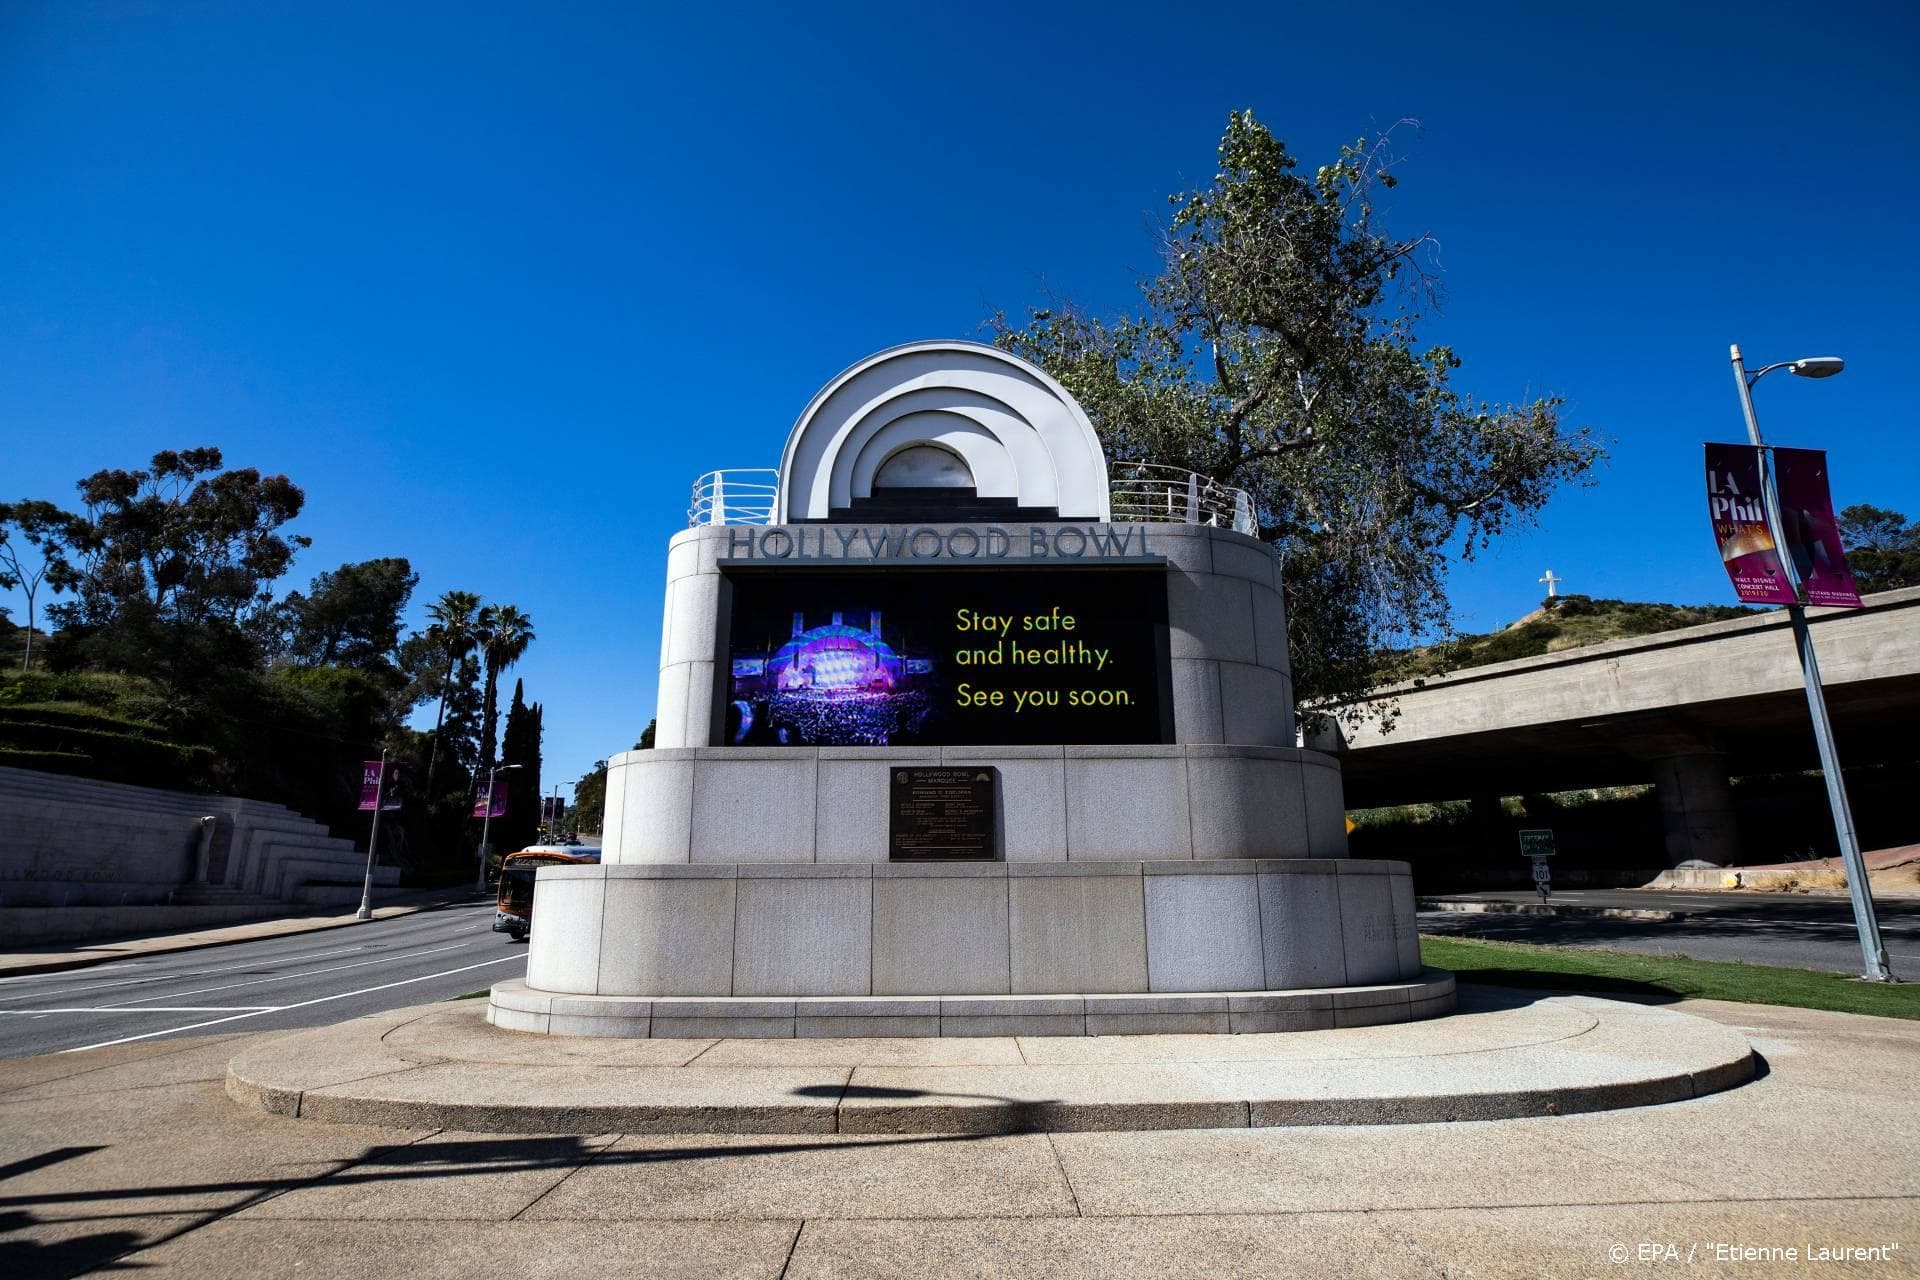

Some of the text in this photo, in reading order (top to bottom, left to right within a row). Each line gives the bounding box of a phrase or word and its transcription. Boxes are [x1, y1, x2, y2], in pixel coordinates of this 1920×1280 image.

[1709, 470, 1740, 494] LA
[1711, 496, 1763, 521] Phil
[728, 526, 1156, 559] HOLLYWOOD BOWL
[956, 606, 1076, 638] Stay safe
[956, 639, 1114, 671] and healthy.
[956, 683, 1136, 713] See you soon.
[1535, 870, 1549, 880] 101
